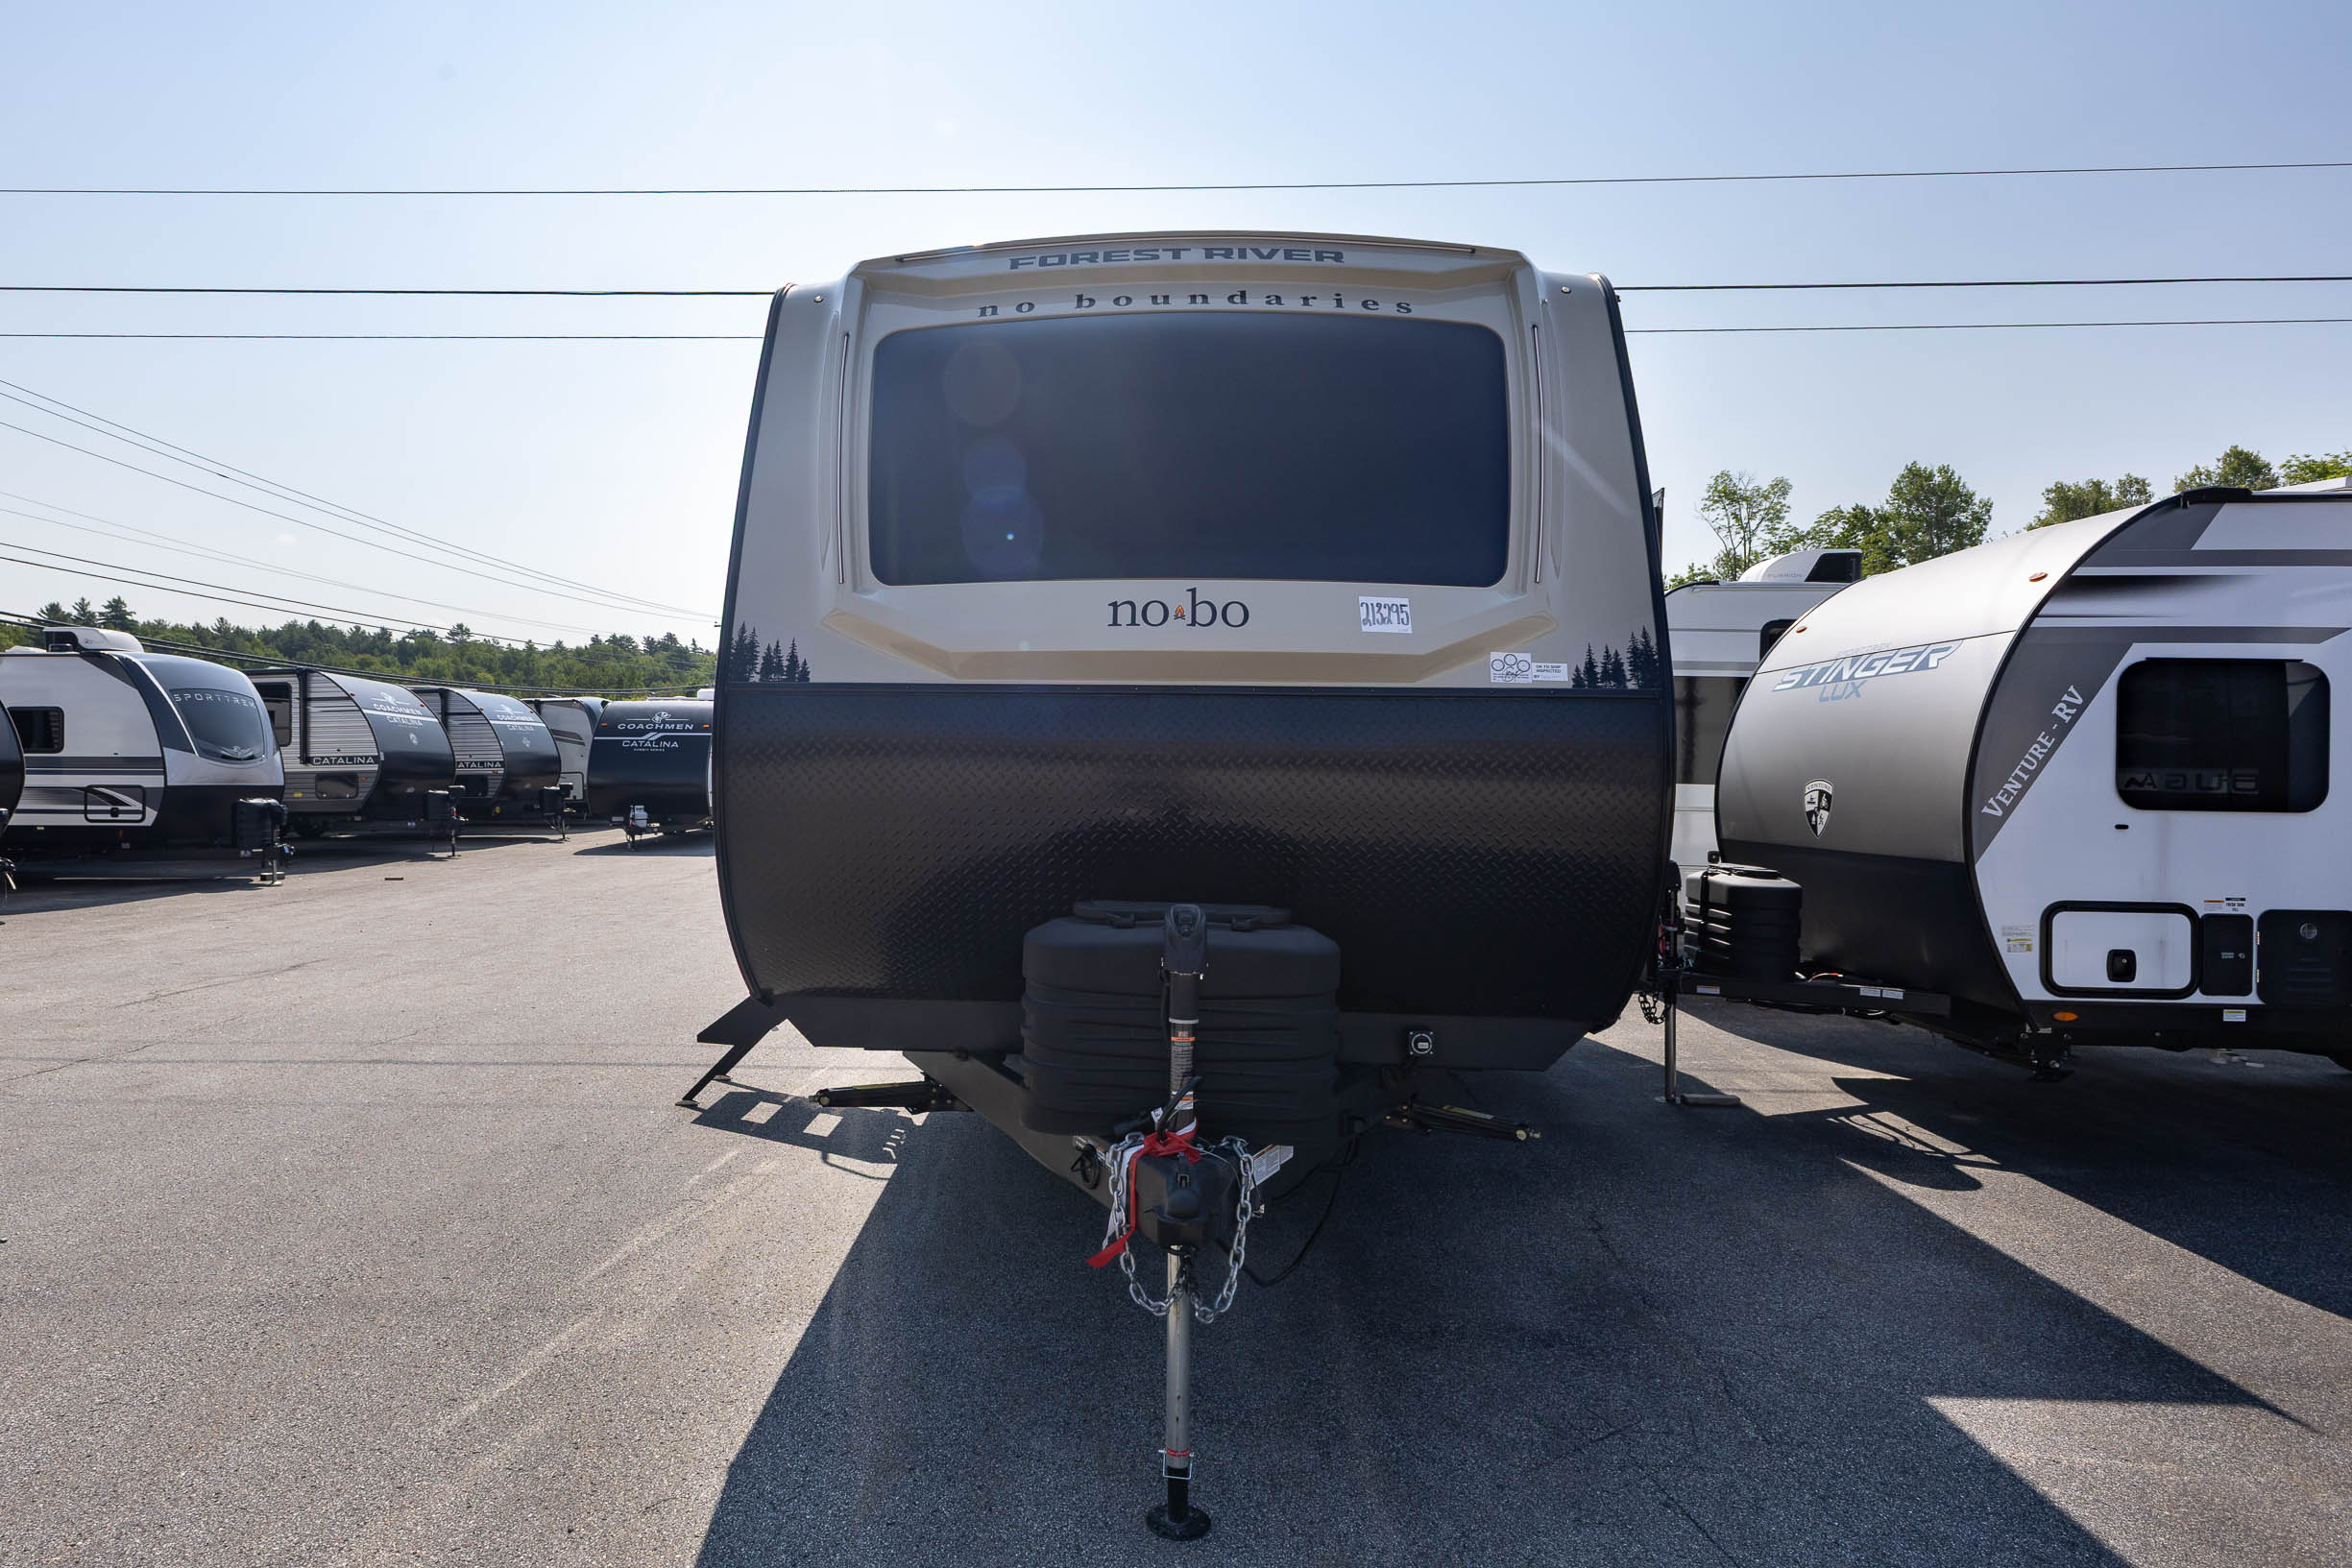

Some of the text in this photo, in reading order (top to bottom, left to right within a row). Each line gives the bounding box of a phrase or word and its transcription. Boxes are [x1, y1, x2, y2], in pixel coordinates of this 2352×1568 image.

[1008, 247, 1346, 270] FOREST RIVER
[977, 289, 1413, 318] no boundaries
[1360, 601, 1410, 627] 213295
[1772, 639, 1963, 692] STINGER
[1818, 681, 1868, 703] LUX
[385, 715, 424, 727] CATALINA
[621, 739, 679, 748] CATALINA
[1981, 731, 2056, 817] VENTURE
[2051, 685, 2084, 724] RV
[312, 756, 376, 766] CATALINA
